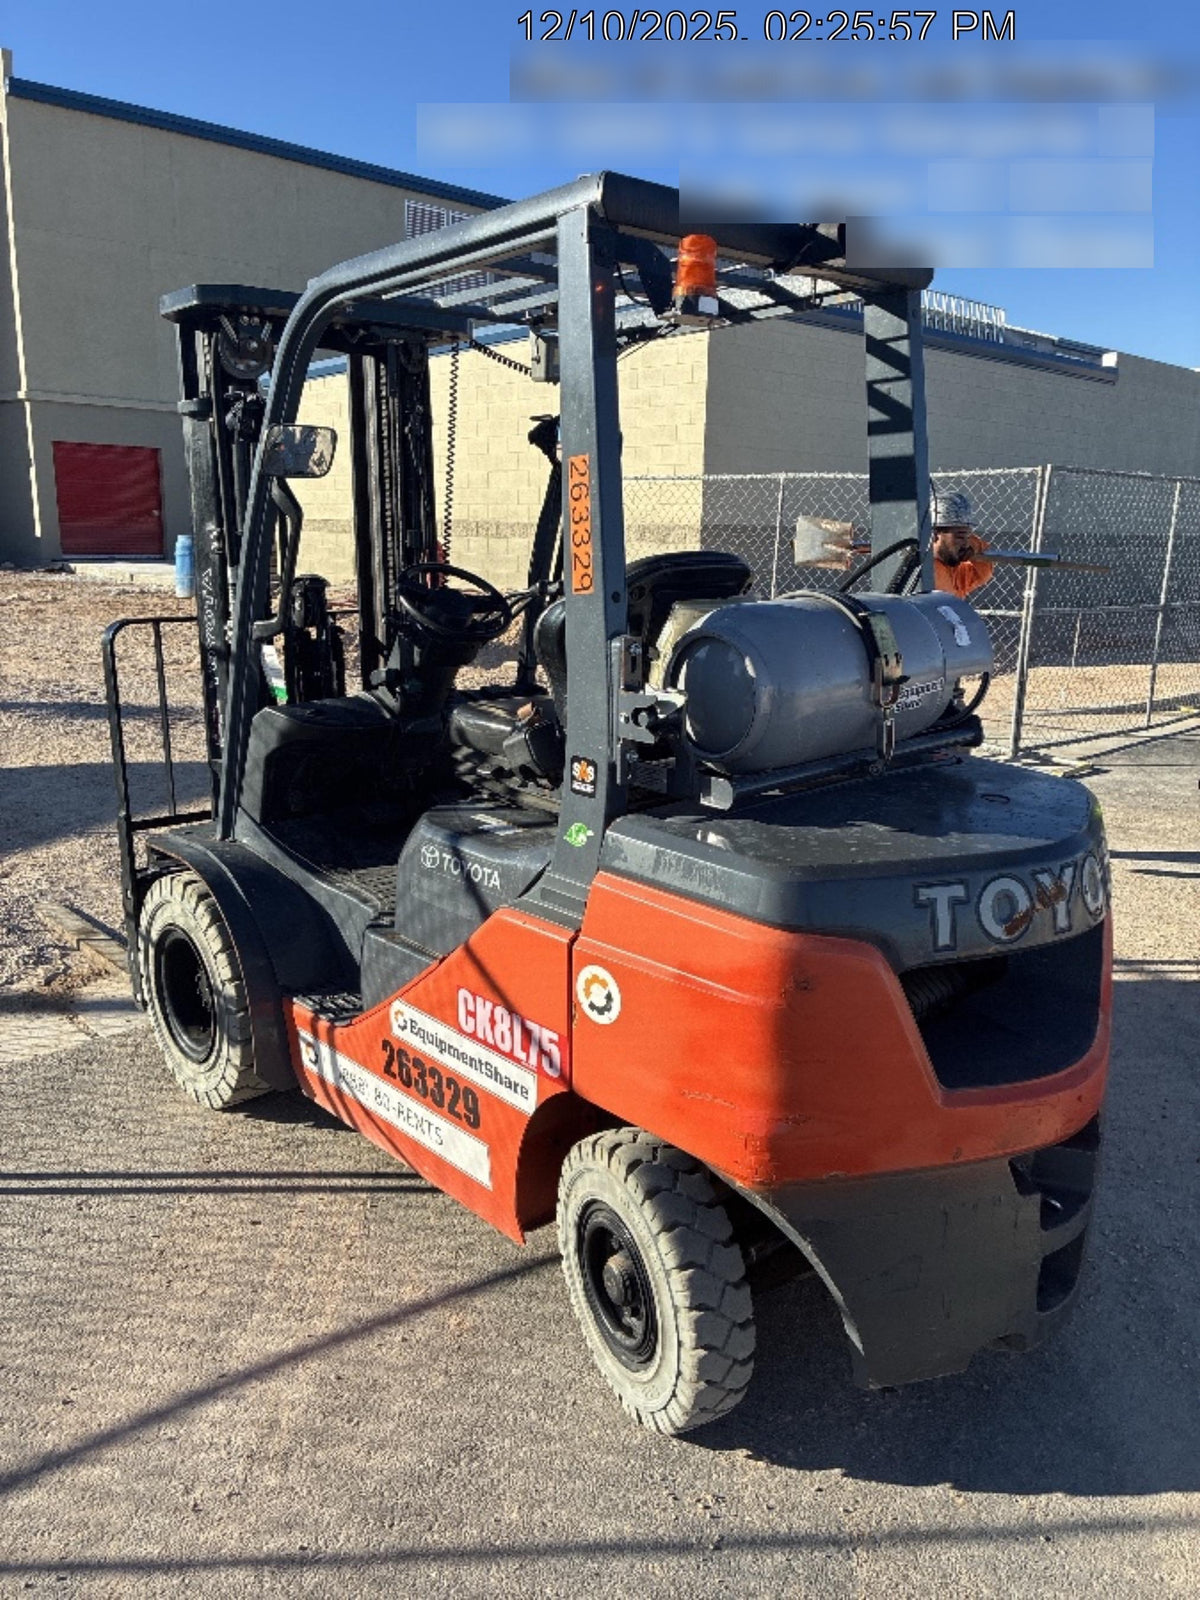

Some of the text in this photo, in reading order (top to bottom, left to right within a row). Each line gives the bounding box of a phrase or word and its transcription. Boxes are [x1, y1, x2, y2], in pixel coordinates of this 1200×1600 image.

[570, 459, 593, 592] 263329
[442, 854, 501, 890] TOYOTA
[408, 1016, 530, 1101] EquipmentShare
[457, 987, 561, 1079] CK8L75
[381, 1038, 481, 1130] 263329
